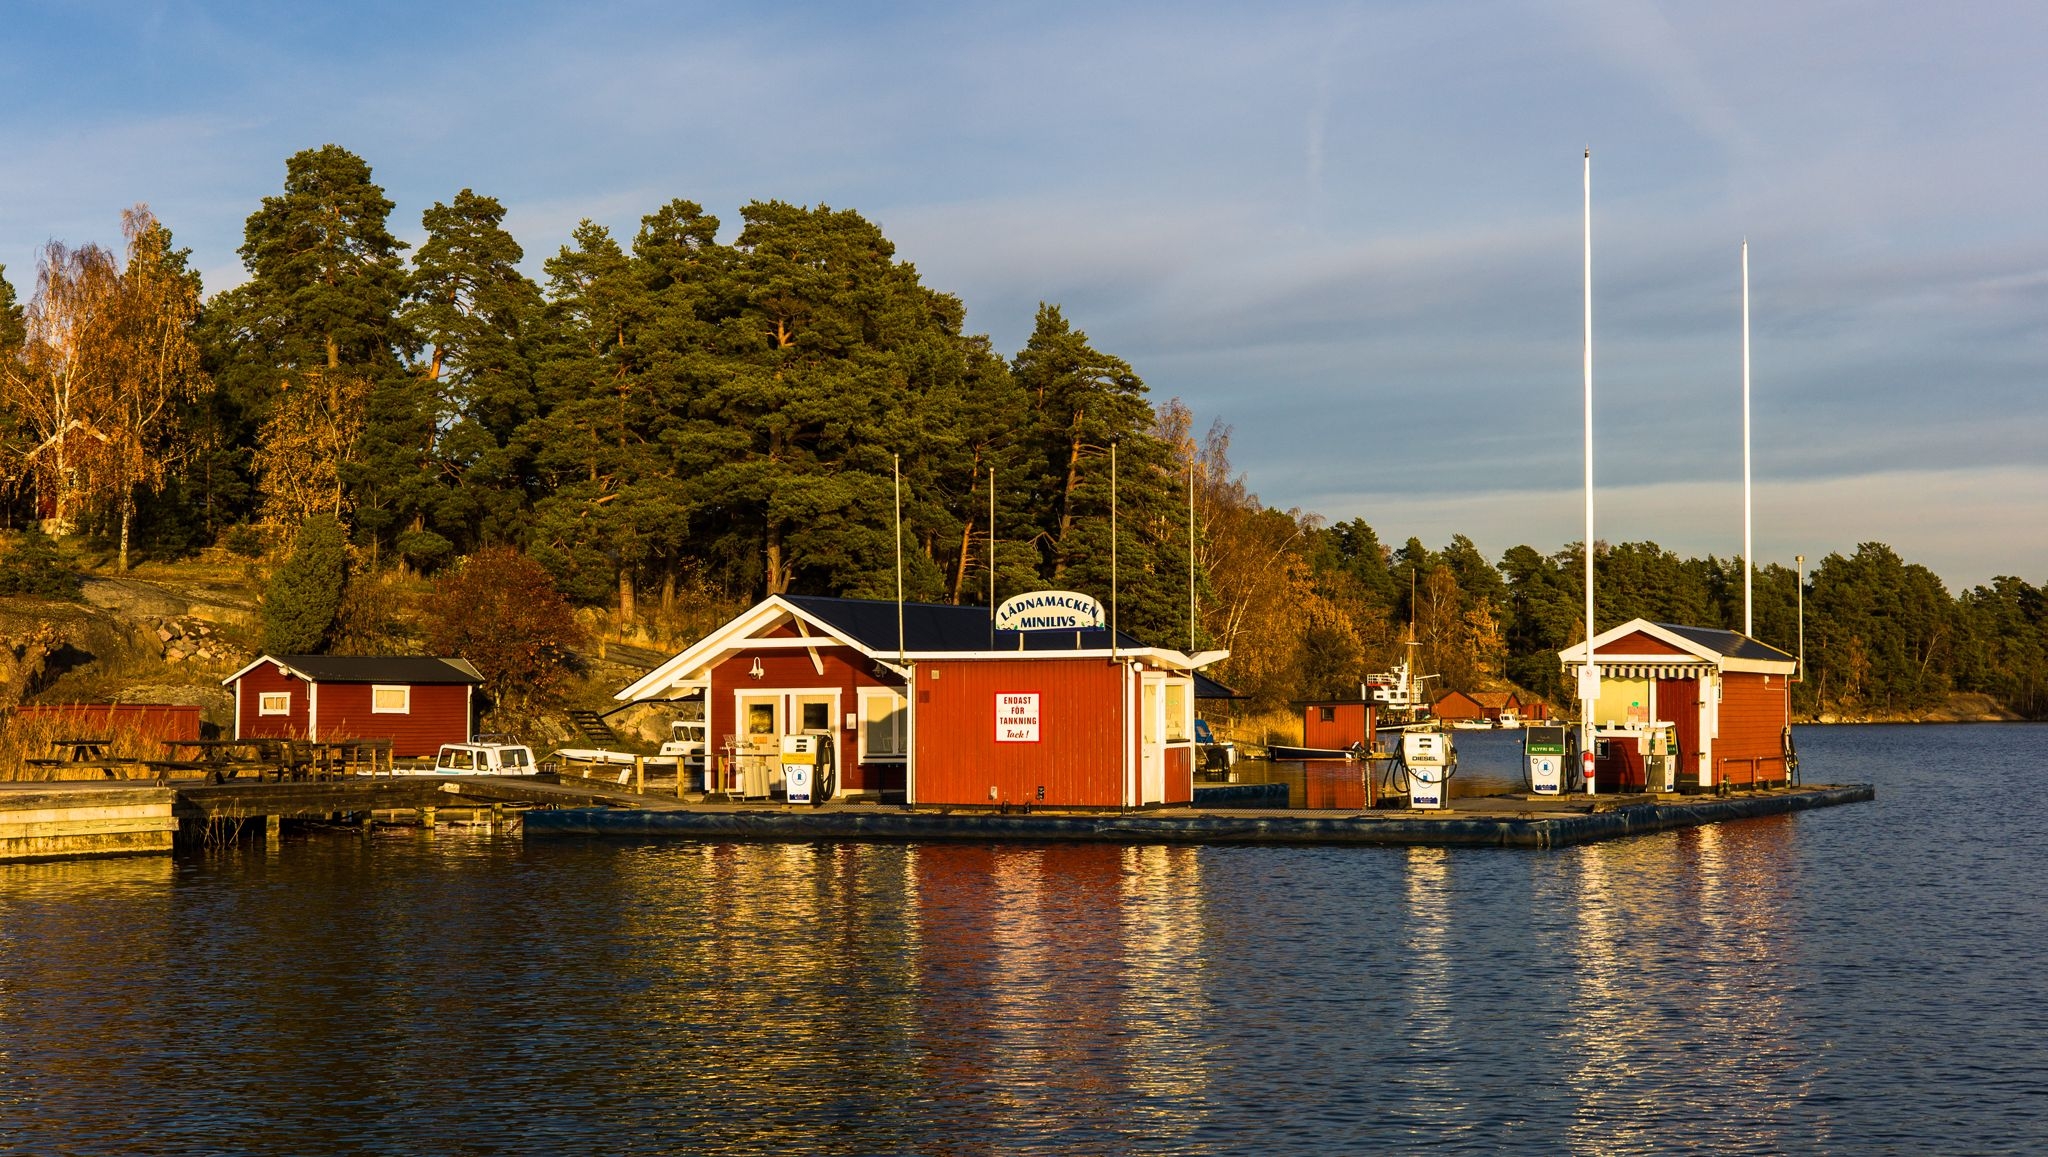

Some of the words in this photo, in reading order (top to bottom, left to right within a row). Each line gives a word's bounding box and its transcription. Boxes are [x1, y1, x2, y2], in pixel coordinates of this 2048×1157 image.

[1000, 596, 1099, 621] LÅDNAMACKEN
[1021, 616, 1076, 628] MINILIVS
[1003, 696, 1031, 704] ENDAST
[1011, 706, 1025, 715] FÖR
[1000, 717, 1037, 725] TANKNING
